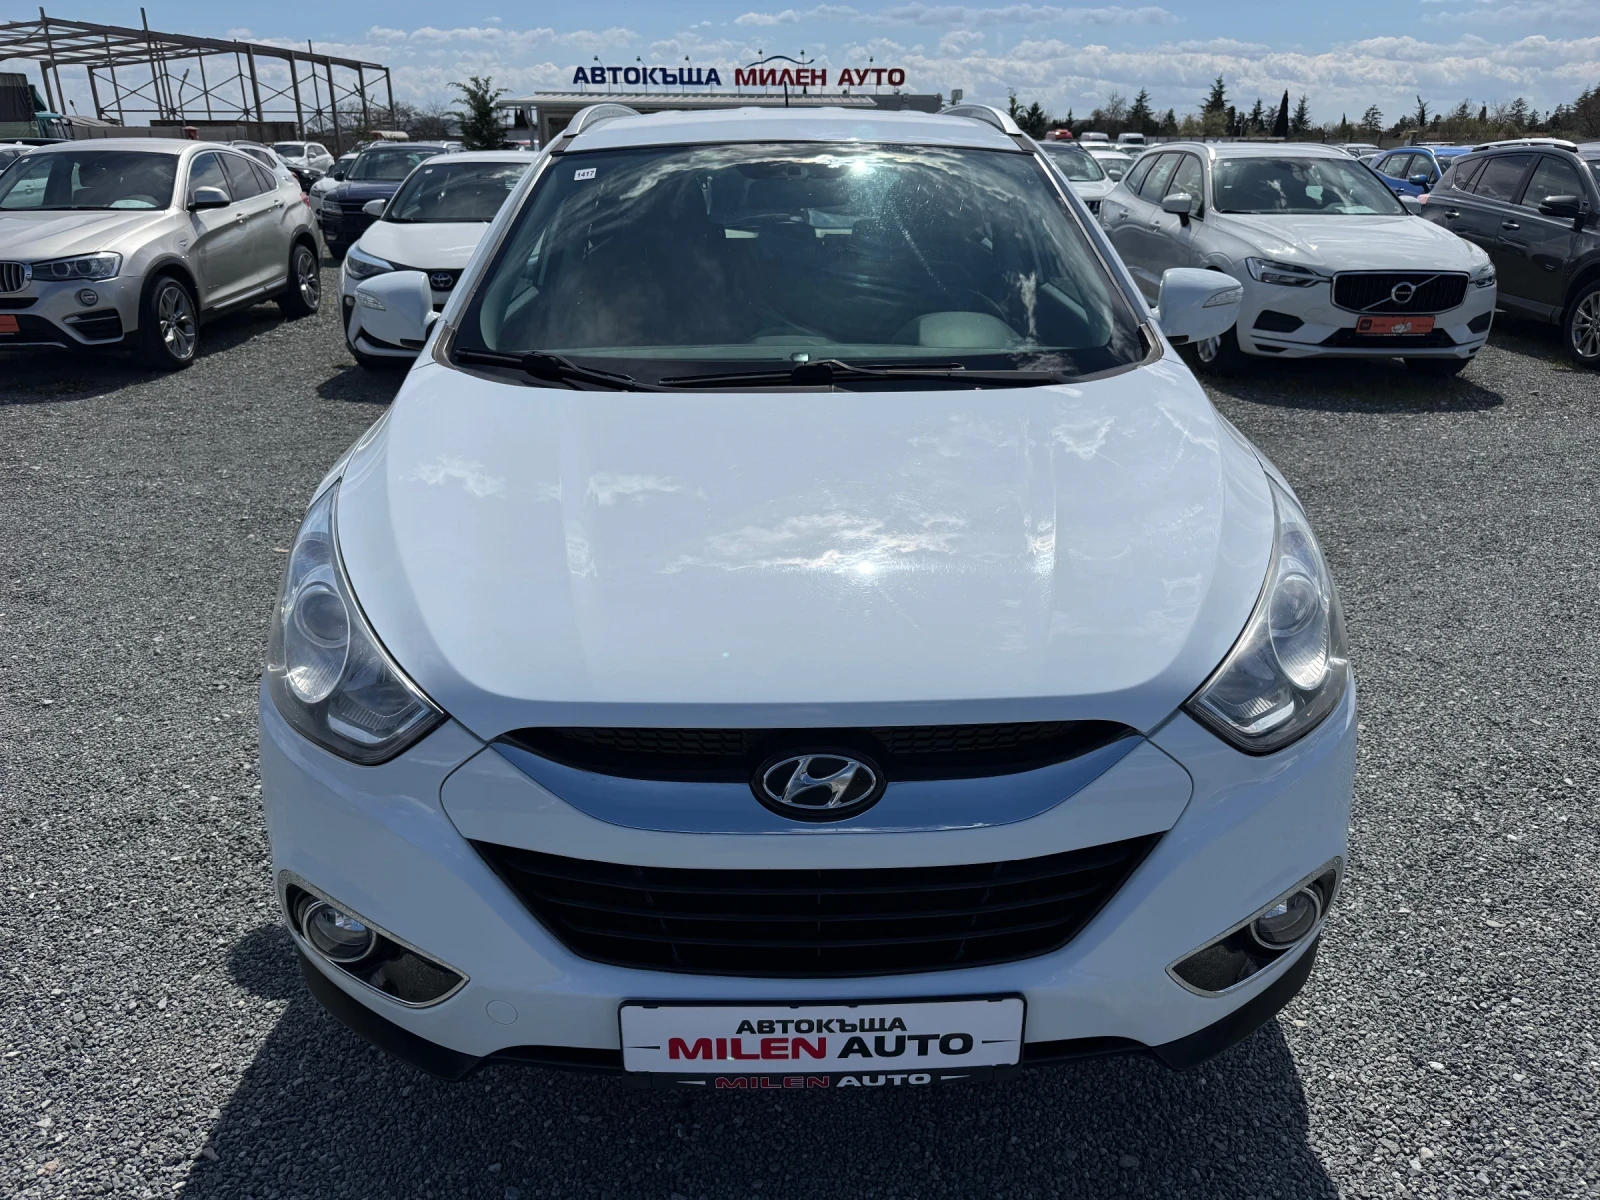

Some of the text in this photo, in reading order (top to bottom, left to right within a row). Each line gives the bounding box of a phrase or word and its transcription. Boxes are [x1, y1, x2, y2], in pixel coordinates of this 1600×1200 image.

[735, 68, 826, 86] МИЛЕН
[837, 68, 905, 86] АУТО
[577, 170, 595, 178] 1417
[668, 1033, 974, 1060] MILEN AUTO
[715, 1074, 931, 1089] MILEN AUTO
